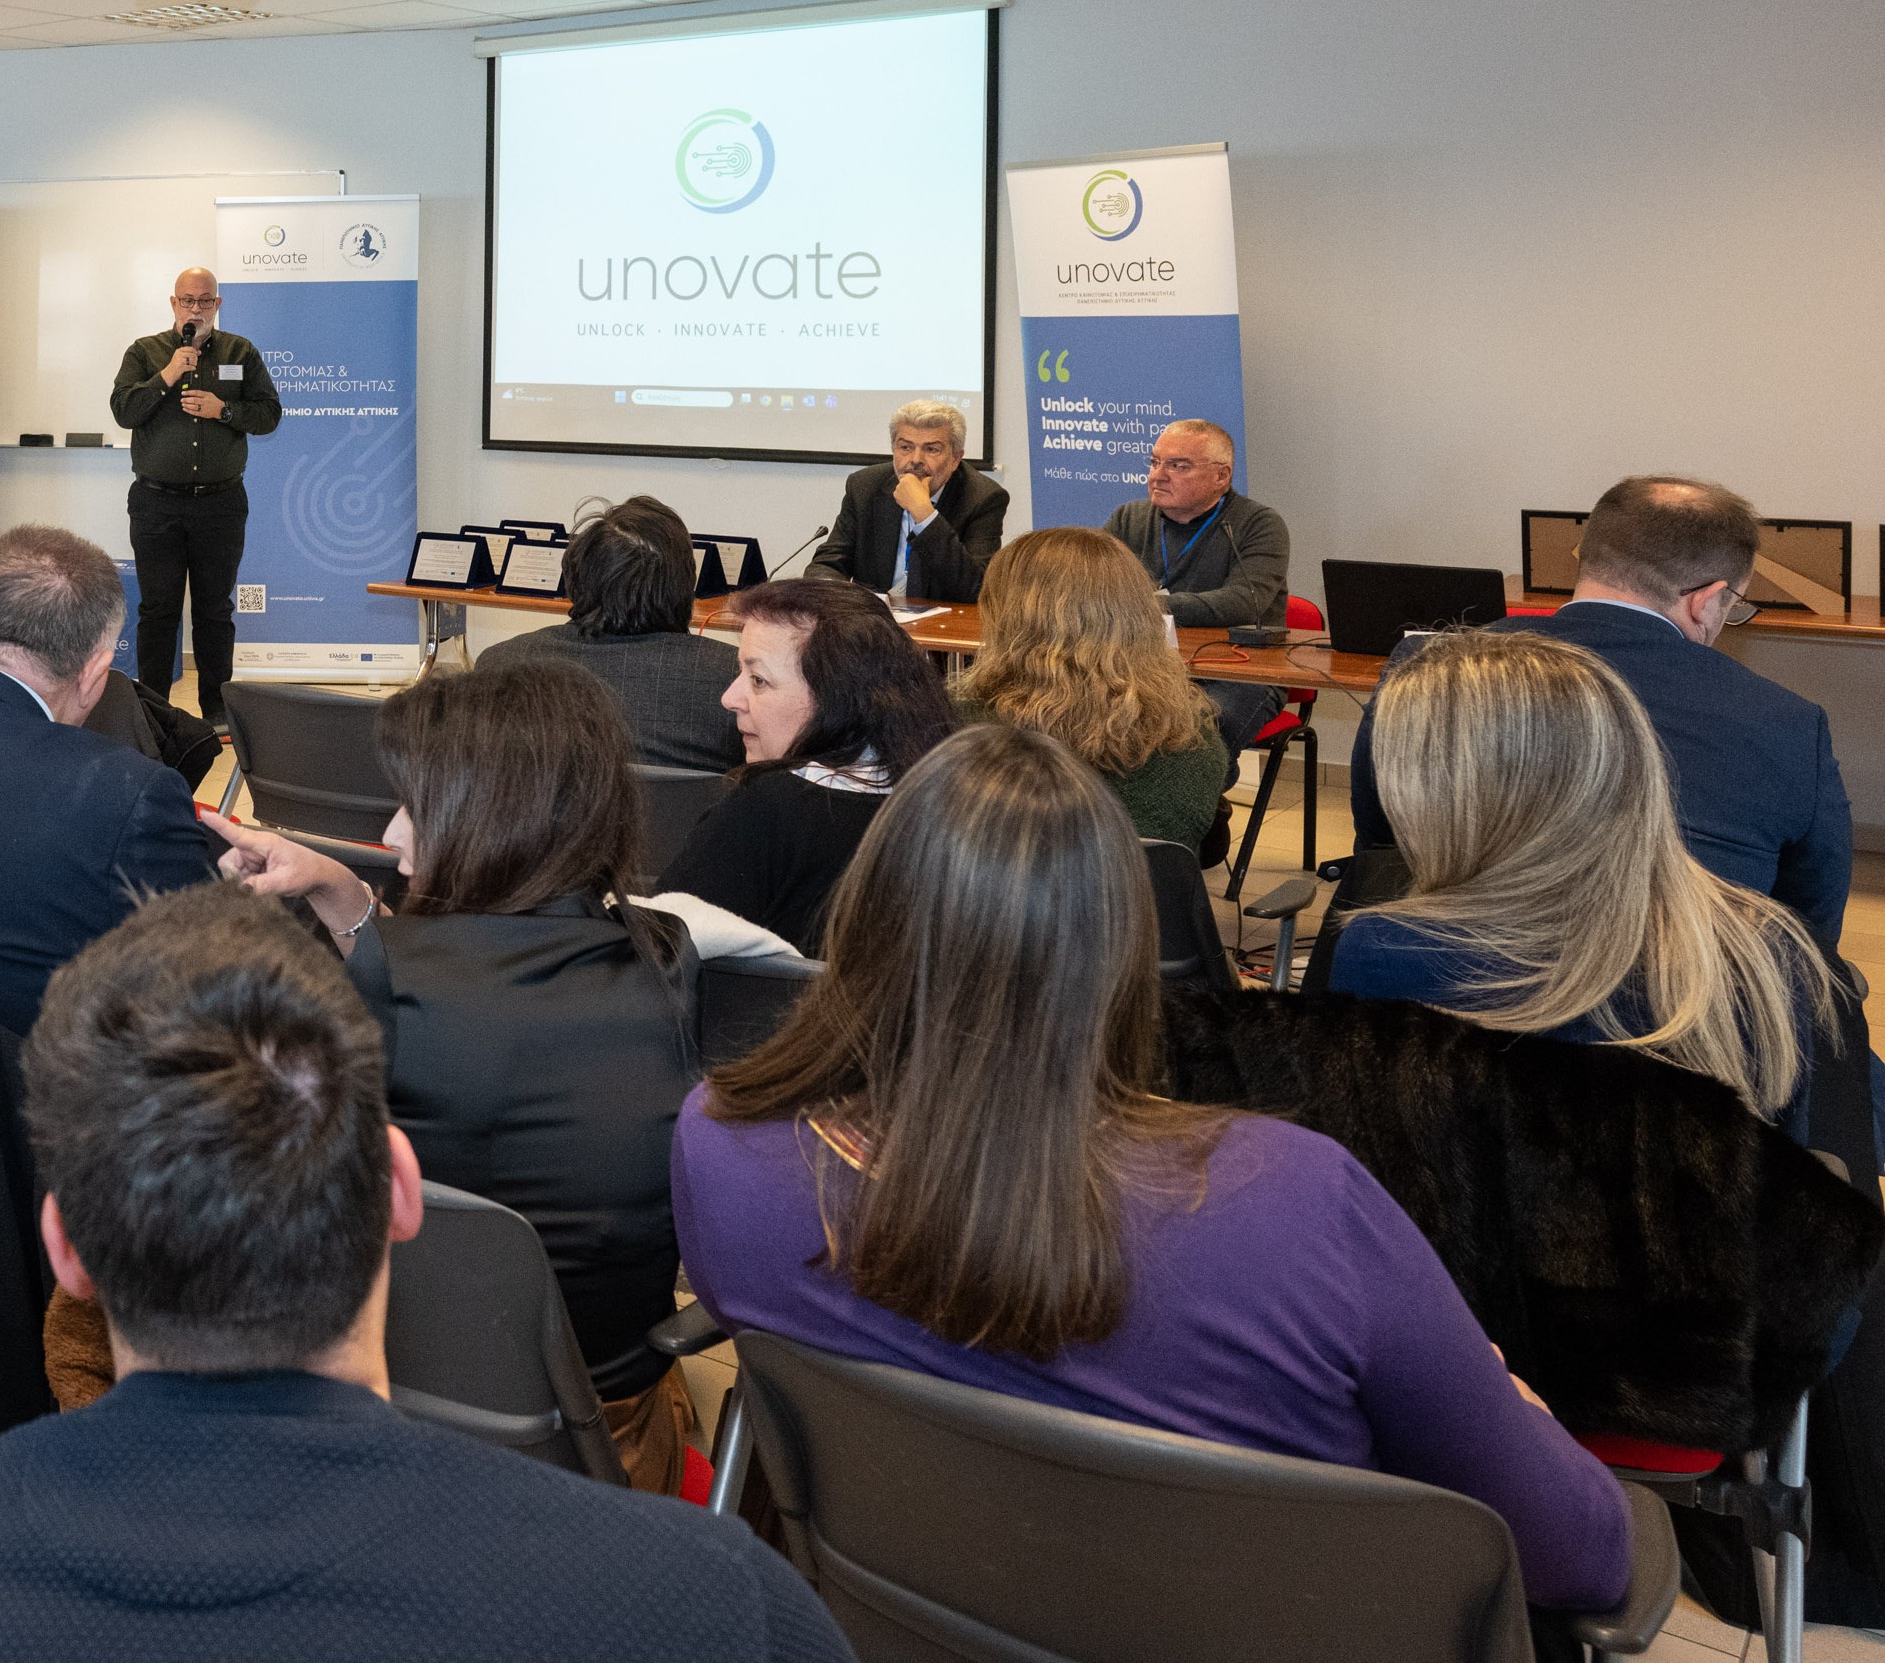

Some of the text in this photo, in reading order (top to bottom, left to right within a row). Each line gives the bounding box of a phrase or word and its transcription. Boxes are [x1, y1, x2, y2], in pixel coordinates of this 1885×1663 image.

[242, 251, 308, 265] unovate
[577, 241, 882, 302] unovate
[1057, 256, 1175, 284] unovate
[576, 322, 881, 337] UNLOCK INNOVATE ACHIEVE
[338, 366, 348, 377] &
[314, 407, 355, 416] ΔΥΤΙΚΗΣ
[357, 407, 399, 415] ΑΤΤΙΚΗΣ
[1041, 396, 1176, 416] Unlock your mind.
[1041, 415, 1108, 432] Innovate
[1112, 418, 1145, 434] with
[1043, 434, 1154, 455] Achieve greatn
[1044, 467, 1073, 480] Μάθε
[1075, 469, 1098, 483] πώς
[1100, 474, 1120, 483] στο
